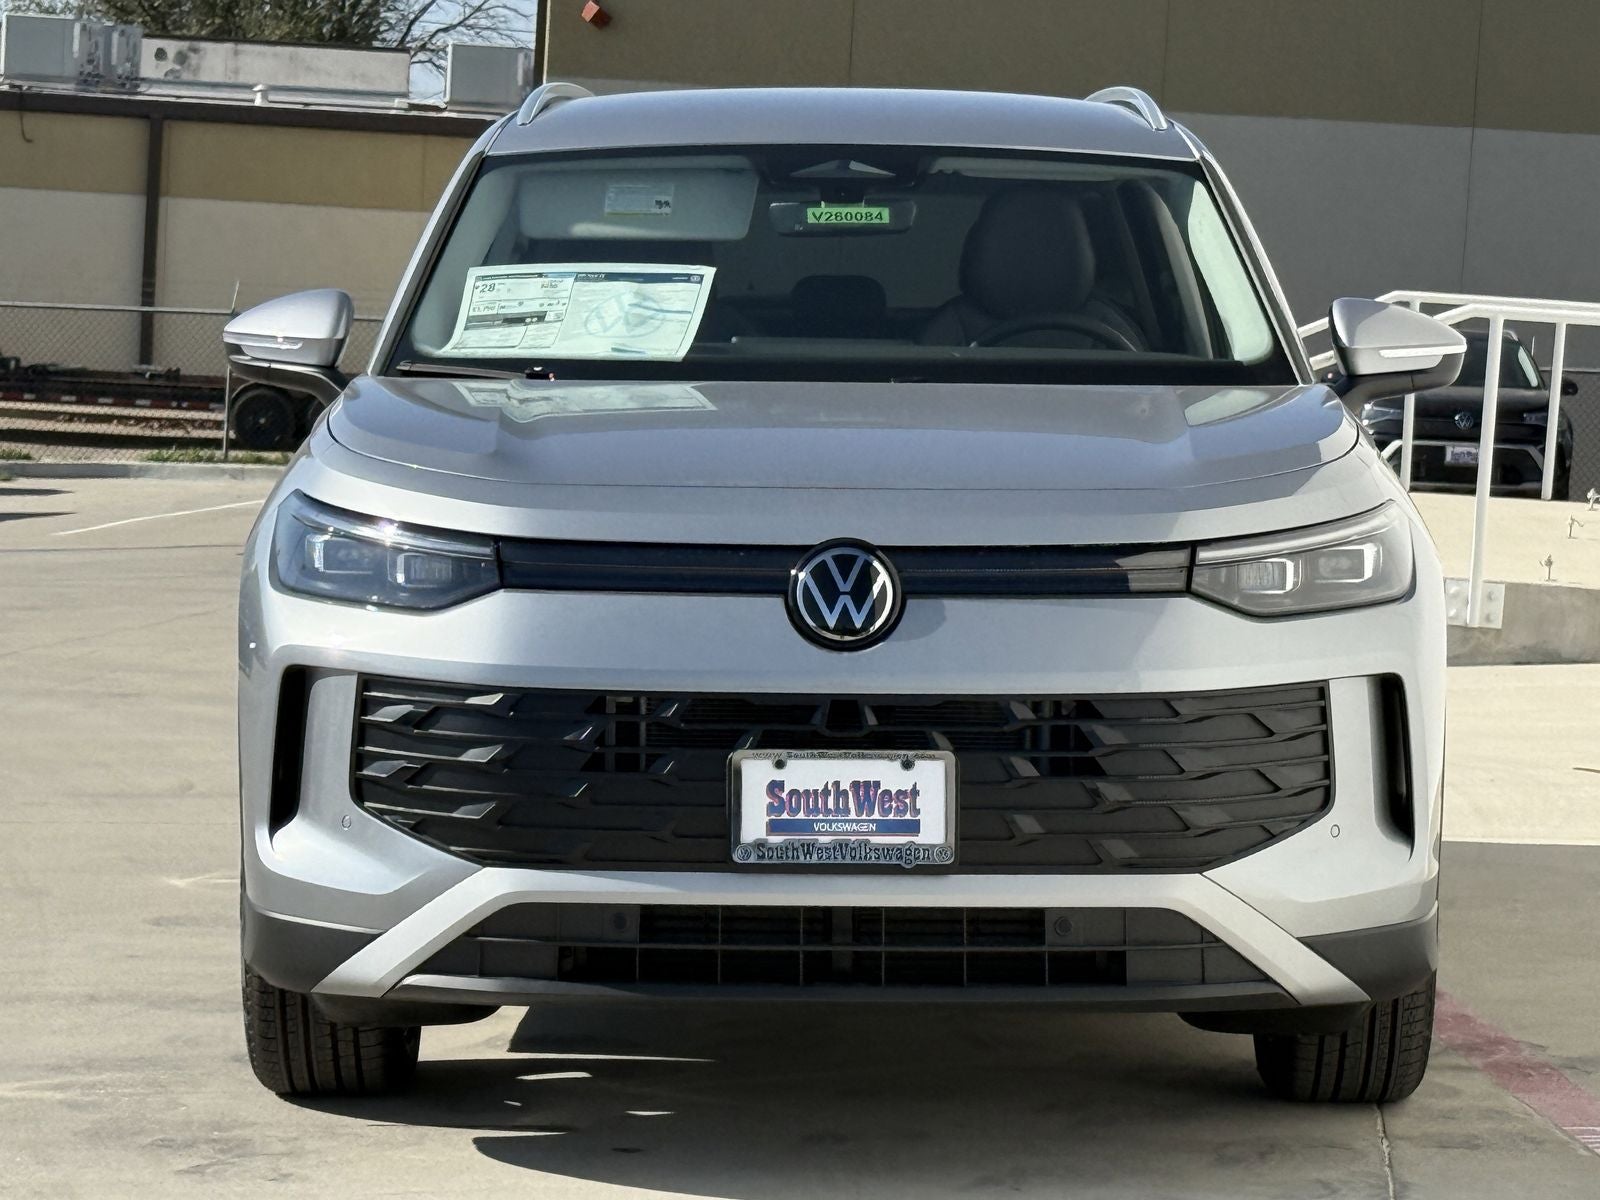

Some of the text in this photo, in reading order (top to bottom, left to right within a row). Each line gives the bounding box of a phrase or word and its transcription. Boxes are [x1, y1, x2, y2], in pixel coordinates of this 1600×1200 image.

[811, 210, 884, 223] V260084
[798, 549, 891, 638] VW
[766, 780, 921, 818] SouthWest
[813, 822, 877, 833] VOLKSWAGEN
